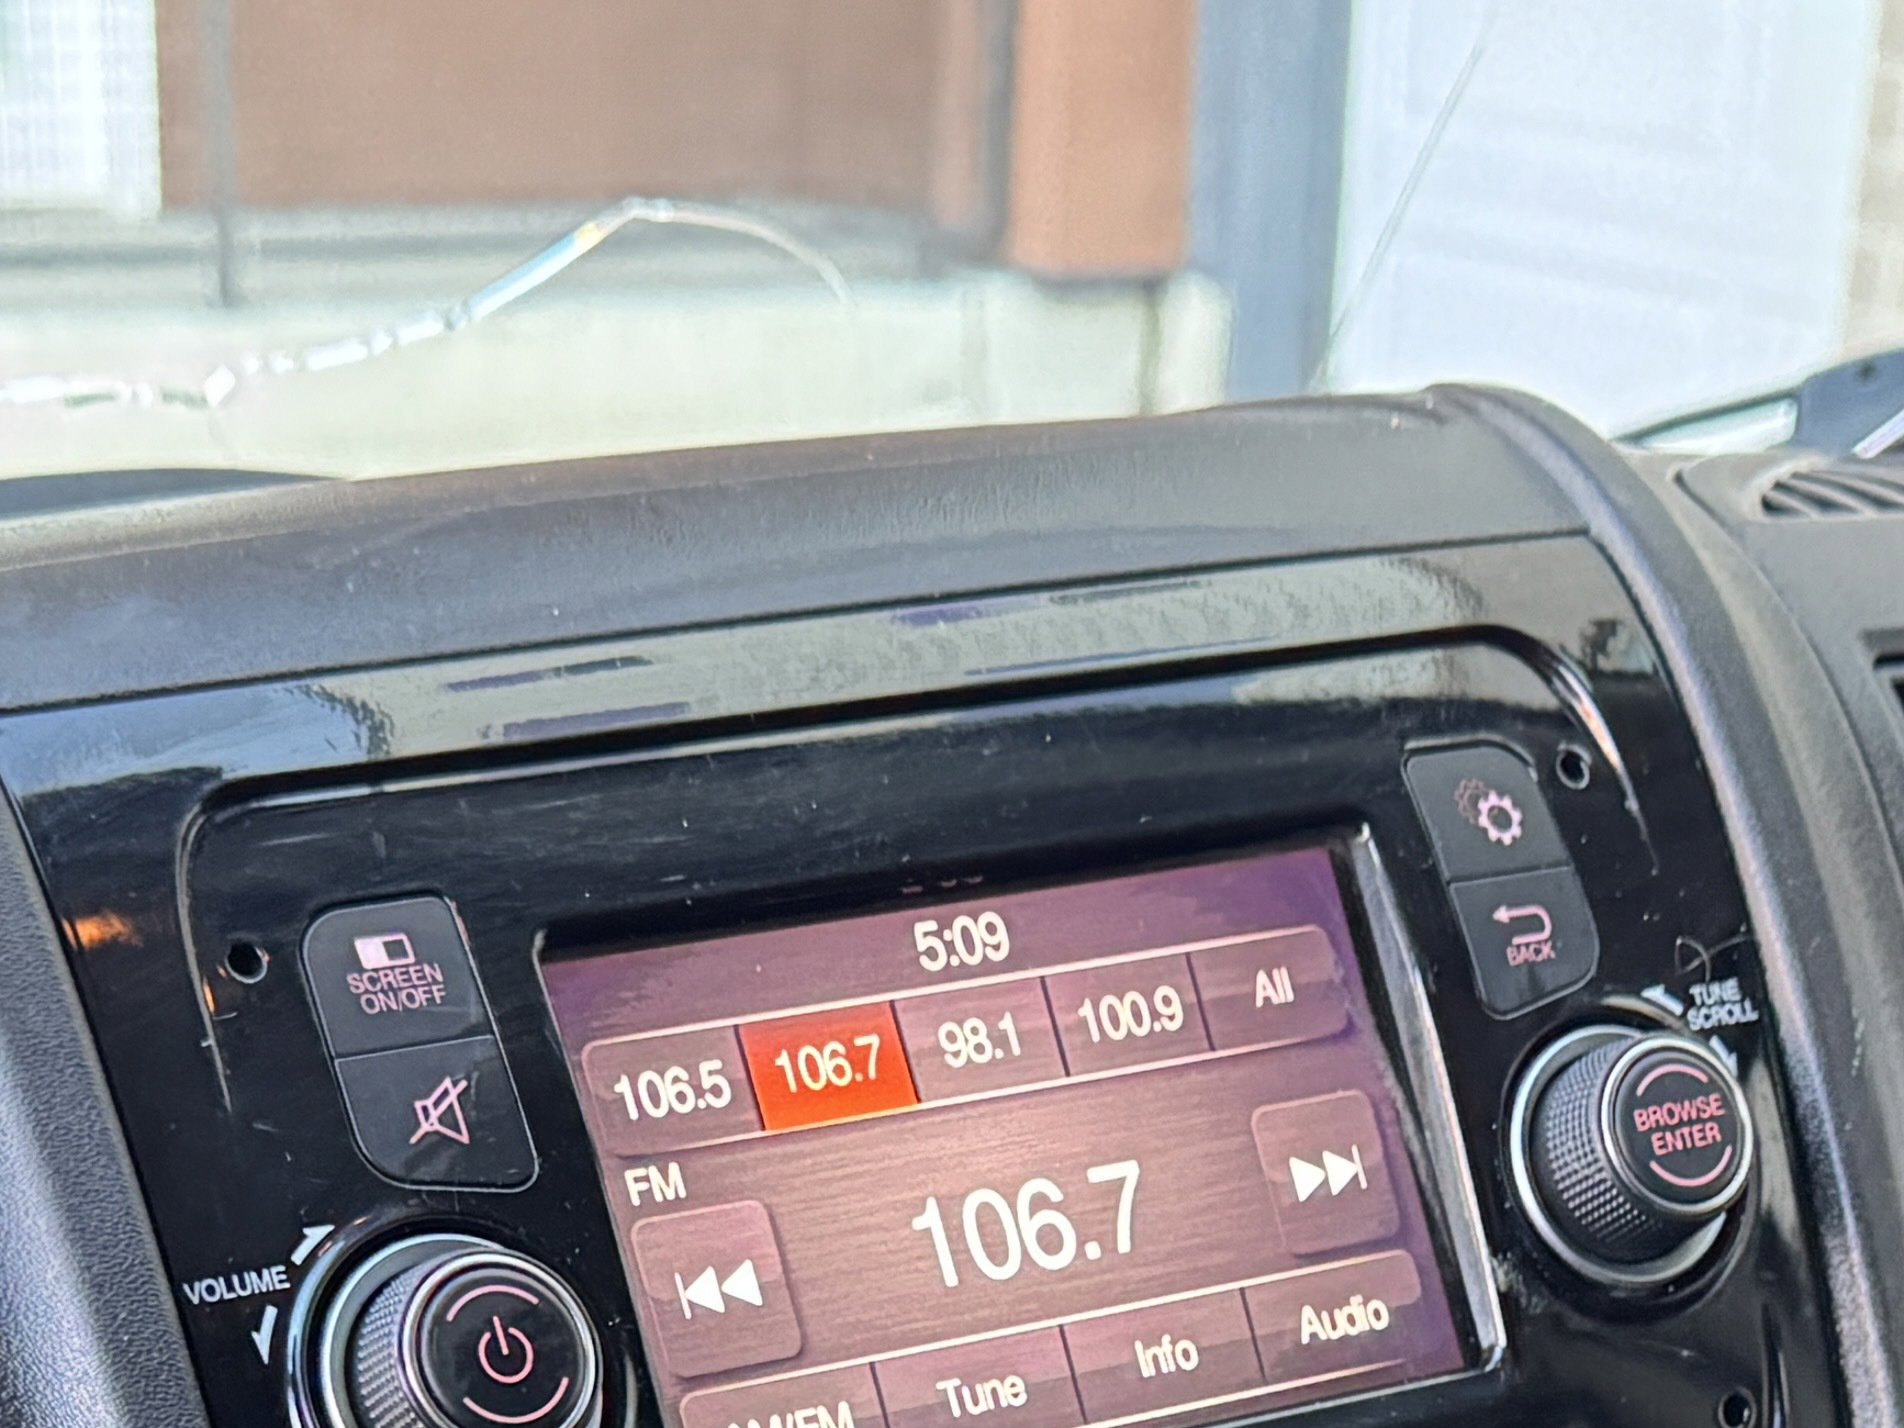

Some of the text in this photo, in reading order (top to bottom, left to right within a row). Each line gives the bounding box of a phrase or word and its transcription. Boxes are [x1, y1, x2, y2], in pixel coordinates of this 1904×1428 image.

[914, 911, 1010, 971] 5:09
[1506, 940, 1556, 967] BACK
[346, 962, 444, 994] SCREEN
[1688, 976, 1743, 1006] TUNE
[360, 984, 446, 1015] ON/OFF
[1686, 996, 1760, 1031] SCROLL
[613, 966, 1294, 1121] 106.5 106.7 98.1 100.9 All
[1633, 1092, 1726, 1132] BROWSE
[1651, 1121, 1722, 1155] ENTER
[624, 1161, 687, 1206] FM
[911, 1159, 1141, 1288] 106.7
[182, 1265, 291, 1305] VOLUME
[935, 1374, 1028, 1418] Tune
[1134, 1333, 1199, 1378] Info
[1300, 1294, 1390, 1345] Audio
